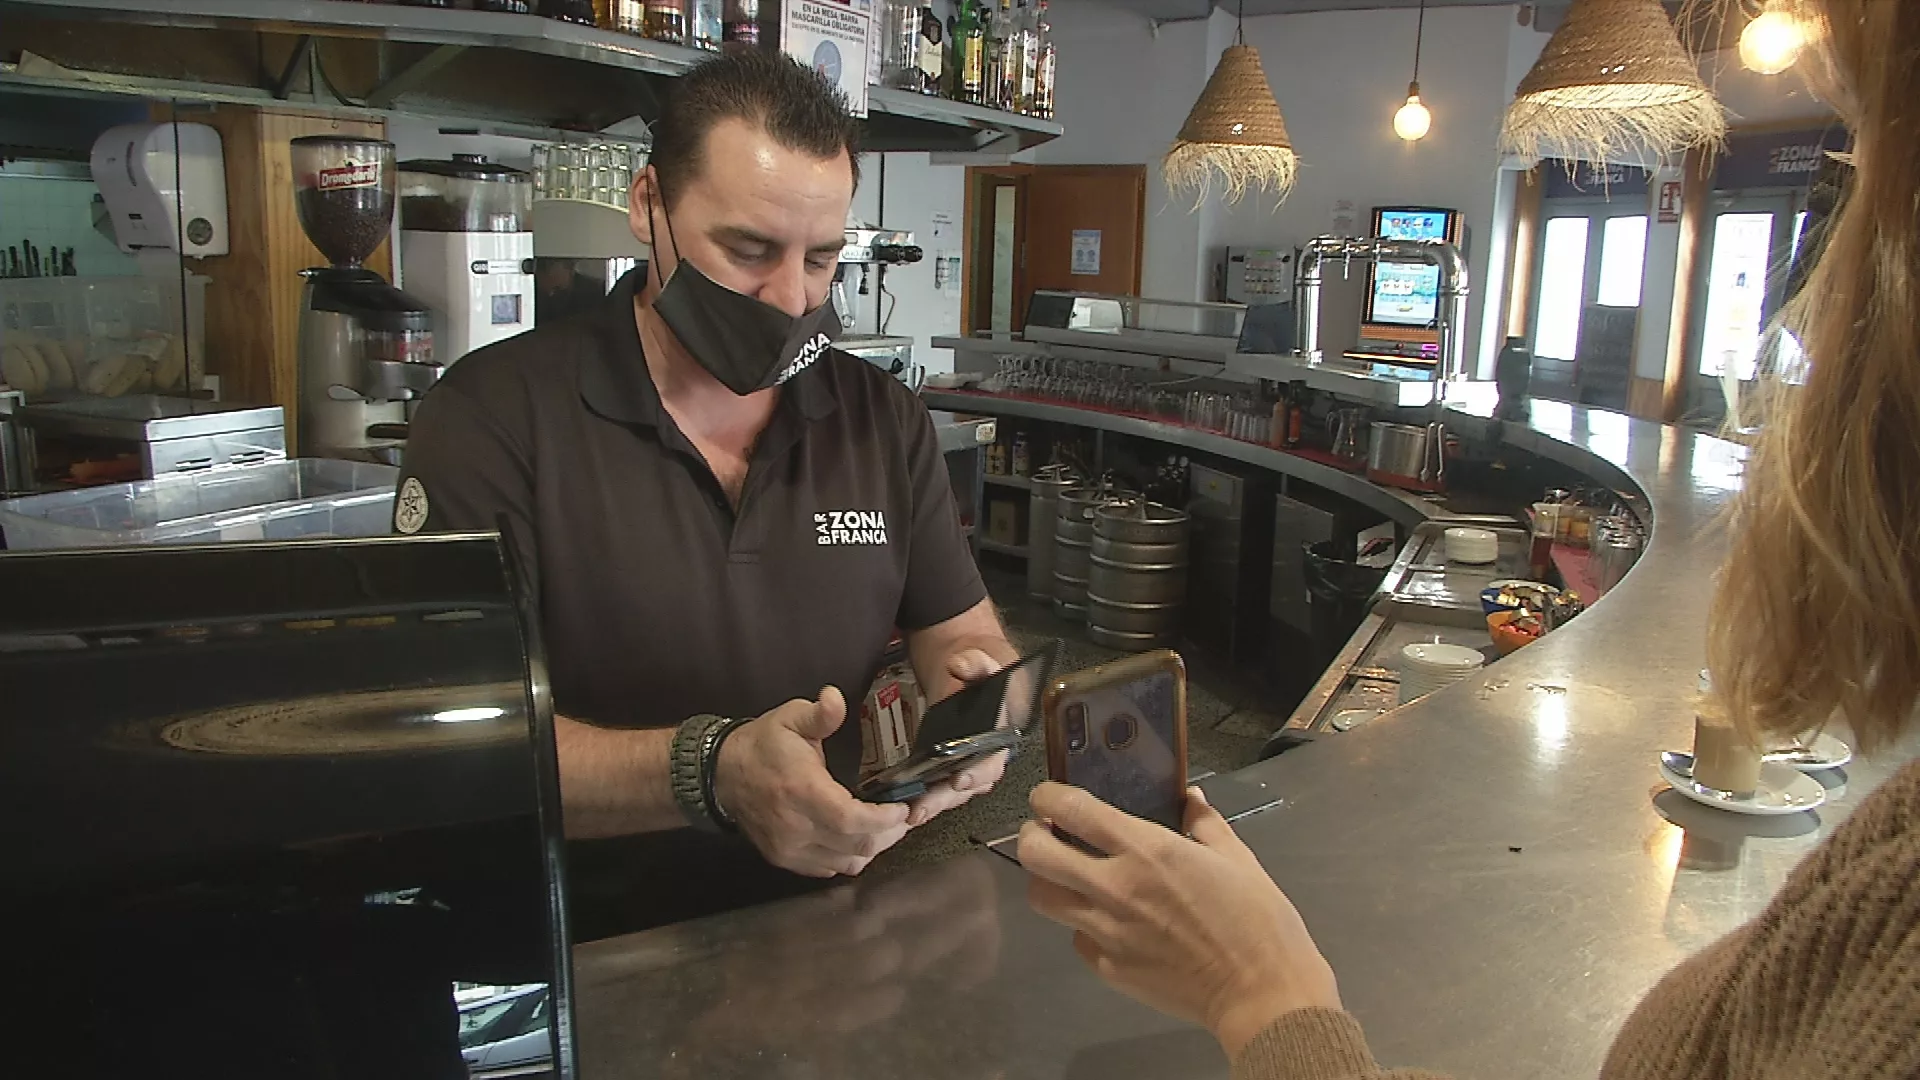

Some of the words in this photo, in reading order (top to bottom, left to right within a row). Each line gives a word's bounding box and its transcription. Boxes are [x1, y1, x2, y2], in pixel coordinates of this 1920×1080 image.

[791, 10, 830, 27] MASCARILLA
[831, 20, 865, 36] OBLIGATORIA
[802, 3, 811, 13] EN
[812, 6, 820, 14] LA
[840, 13, 858, 24] BARRA
[1780, 145, 1822, 160] ZONA
[814, 513, 831, 545] BAR
[829, 511, 885, 529] ZONA
[831, 529, 887, 545] FRANCA
